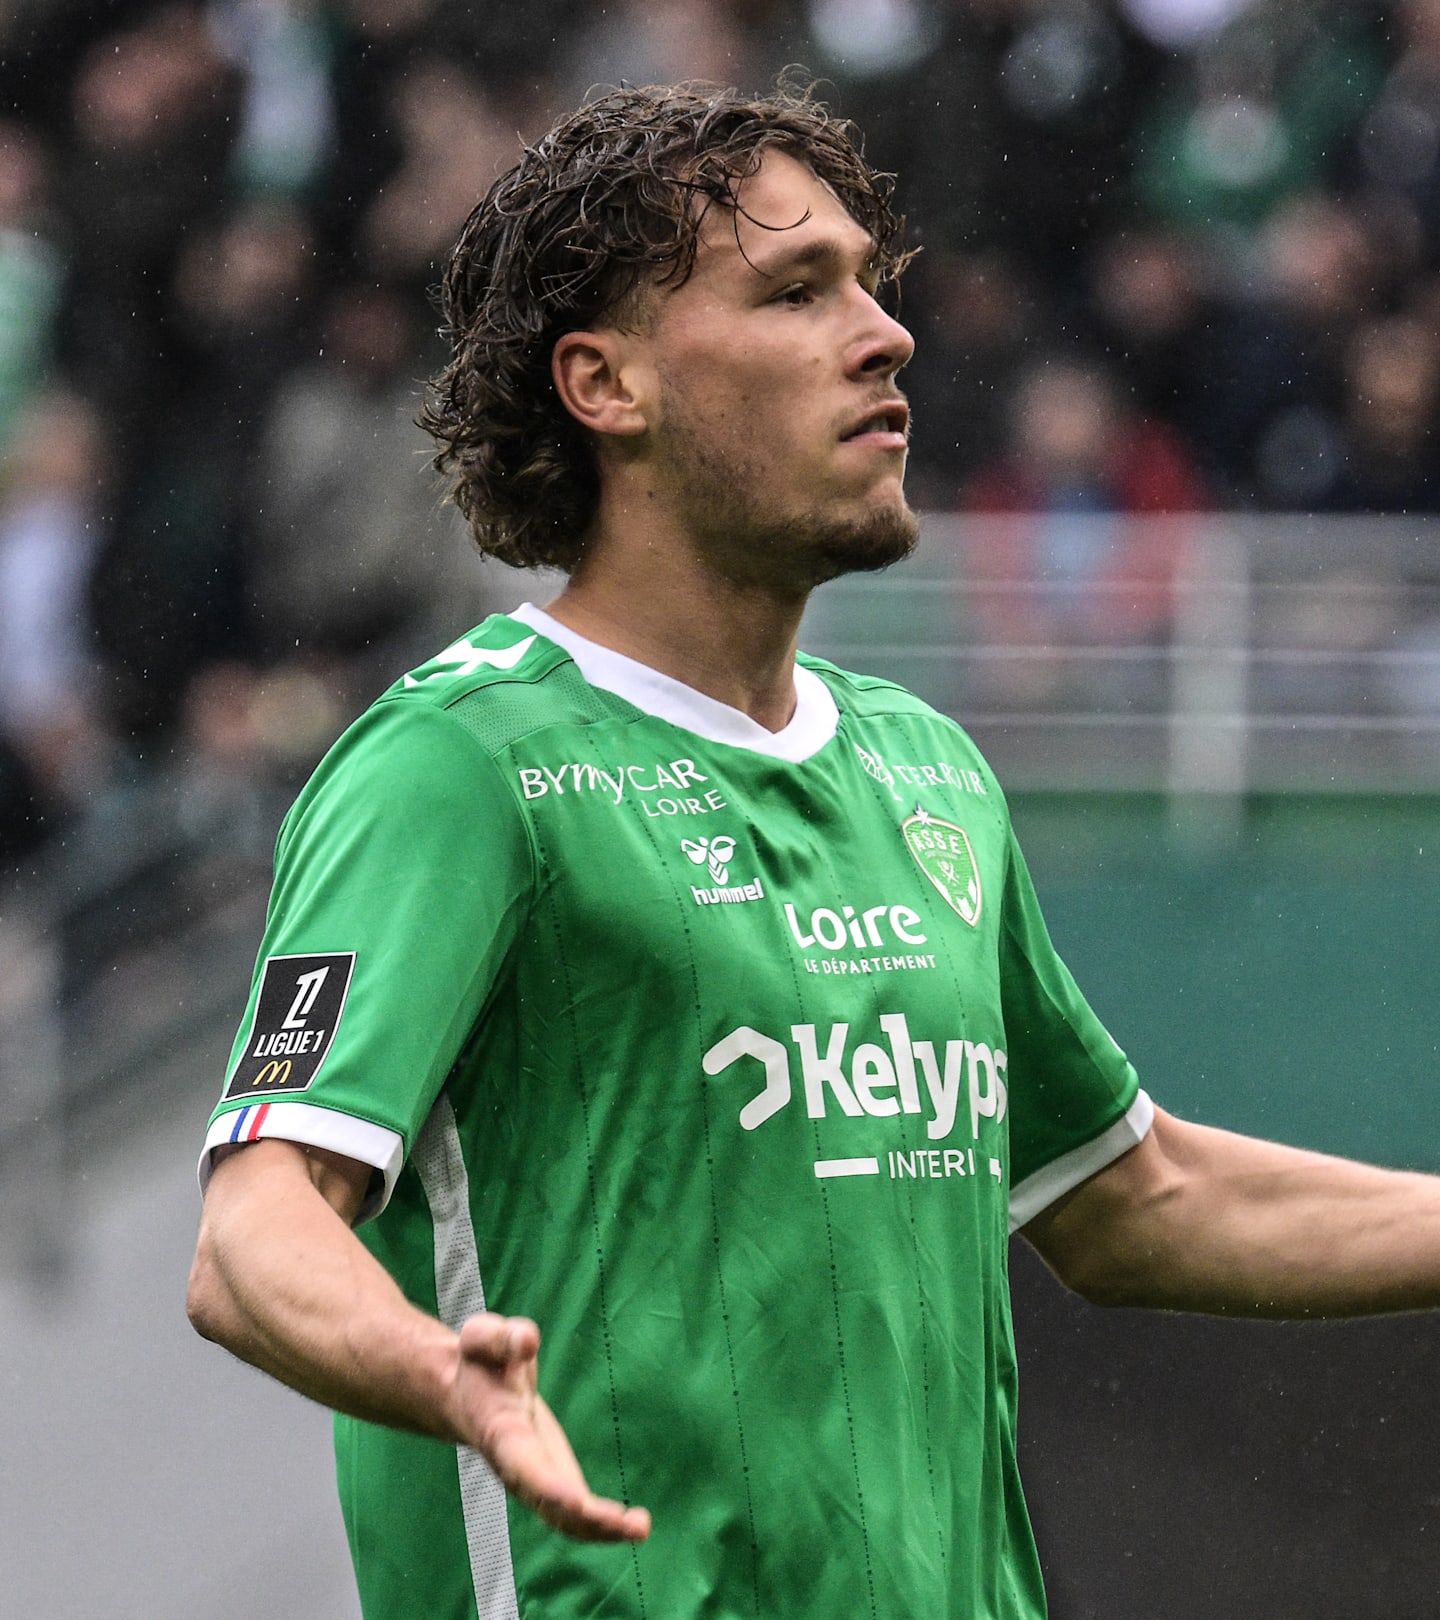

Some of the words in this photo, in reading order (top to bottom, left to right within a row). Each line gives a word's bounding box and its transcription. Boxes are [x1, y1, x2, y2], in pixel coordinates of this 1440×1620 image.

[641, 789, 727, 817] LOIRE
[911, 829, 962, 855] ASSE
[691, 877, 764, 905] hummel
[784, 903, 928, 950] Loire
[803, 958, 819, 973] LE
[821, 954, 936, 975] DÉPARTEMENT
